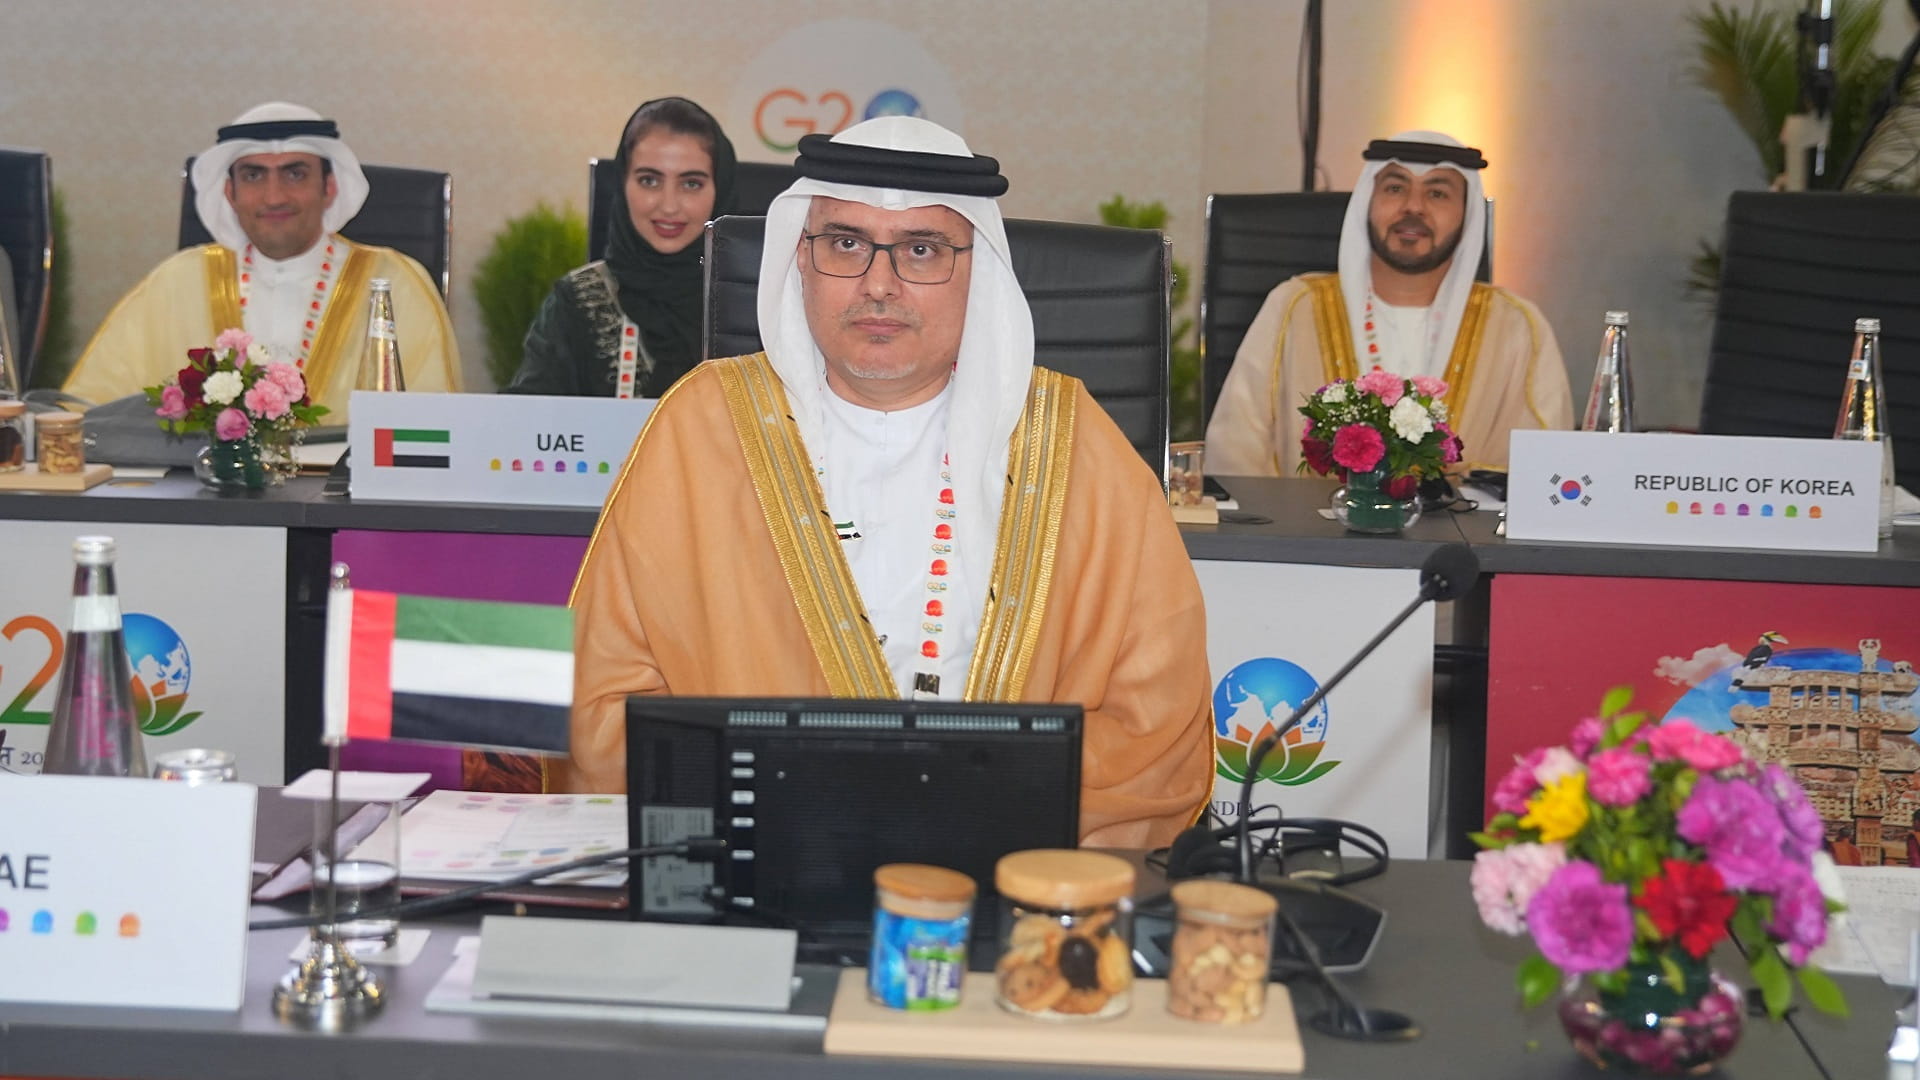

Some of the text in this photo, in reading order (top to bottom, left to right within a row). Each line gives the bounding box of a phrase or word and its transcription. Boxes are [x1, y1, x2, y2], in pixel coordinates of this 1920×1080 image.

[537, 433, 584, 452] UAE
[1635, 474, 1855, 497] REPUBLIC OF KOREA
[21, 752, 43, 765] 20
[0, 853, 51, 890] AE
